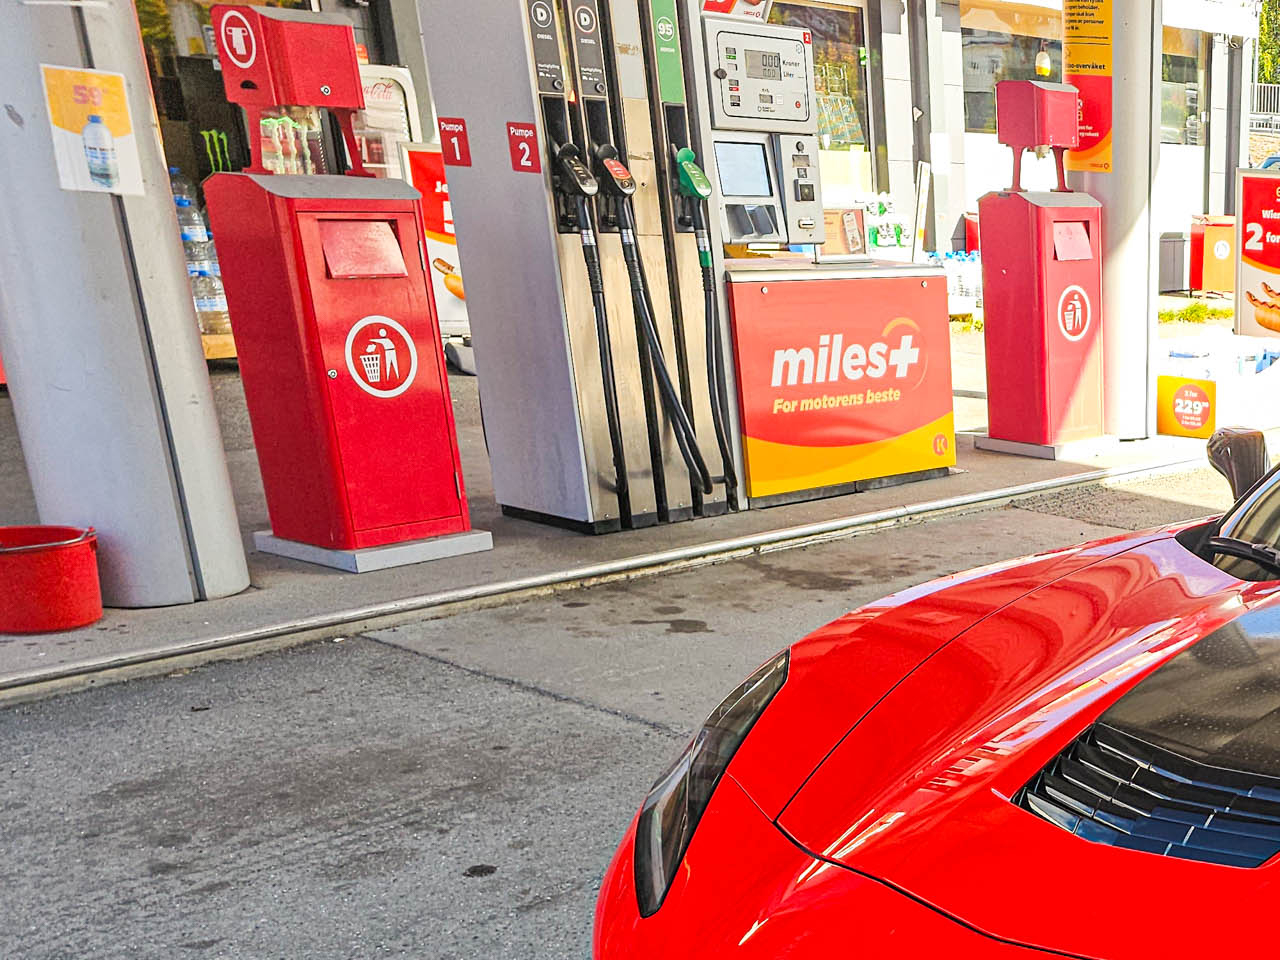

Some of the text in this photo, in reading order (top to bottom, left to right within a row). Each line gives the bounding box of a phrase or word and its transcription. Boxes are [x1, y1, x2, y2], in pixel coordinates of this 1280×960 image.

[536, 8, 547, 21] D
[580, 12, 591, 26] D
[658, 22, 673, 36] 95
[441, 121, 464, 133] Pumpe
[509, 126, 534, 138] Pumpe
[450, 136, 461, 160] 1
[518, 142, 532, 167] 2
[1245, 223, 1263, 251] 2
[1266, 231, 1280, 243] for
[773, 387, 901, 414] For motorens beste
